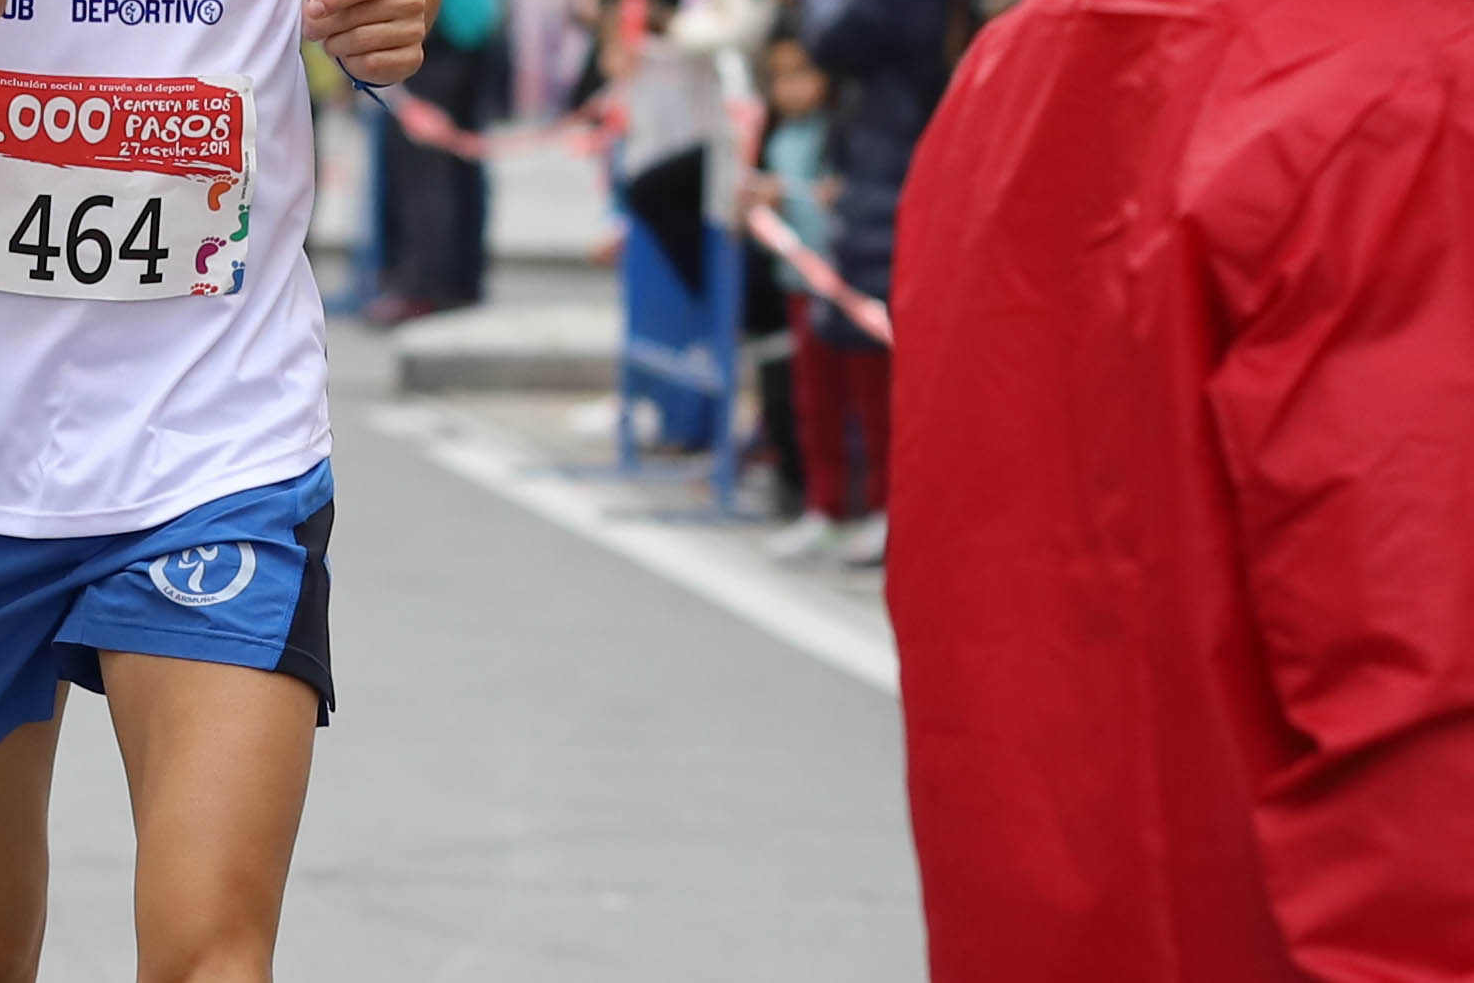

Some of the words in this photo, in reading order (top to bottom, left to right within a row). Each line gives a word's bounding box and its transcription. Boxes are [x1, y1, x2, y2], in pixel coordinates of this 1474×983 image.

[50, 82, 83, 91] social
[99, 84, 133, 92] través
[134, 84, 153, 93] del
[155, 84, 195, 94] deporte
[112, 95, 122, 111] X
[123, 100, 182, 113] CARRERA
[186, 99, 200, 111] DE
[203, 98, 231, 111] LOS
[126, 114, 230, 143] PASOS
[119, 141, 141, 156] 27
[142, 141, 197, 158] octubre
[199, 140, 230, 156] 2019
[8, 194, 169, 284] 464
